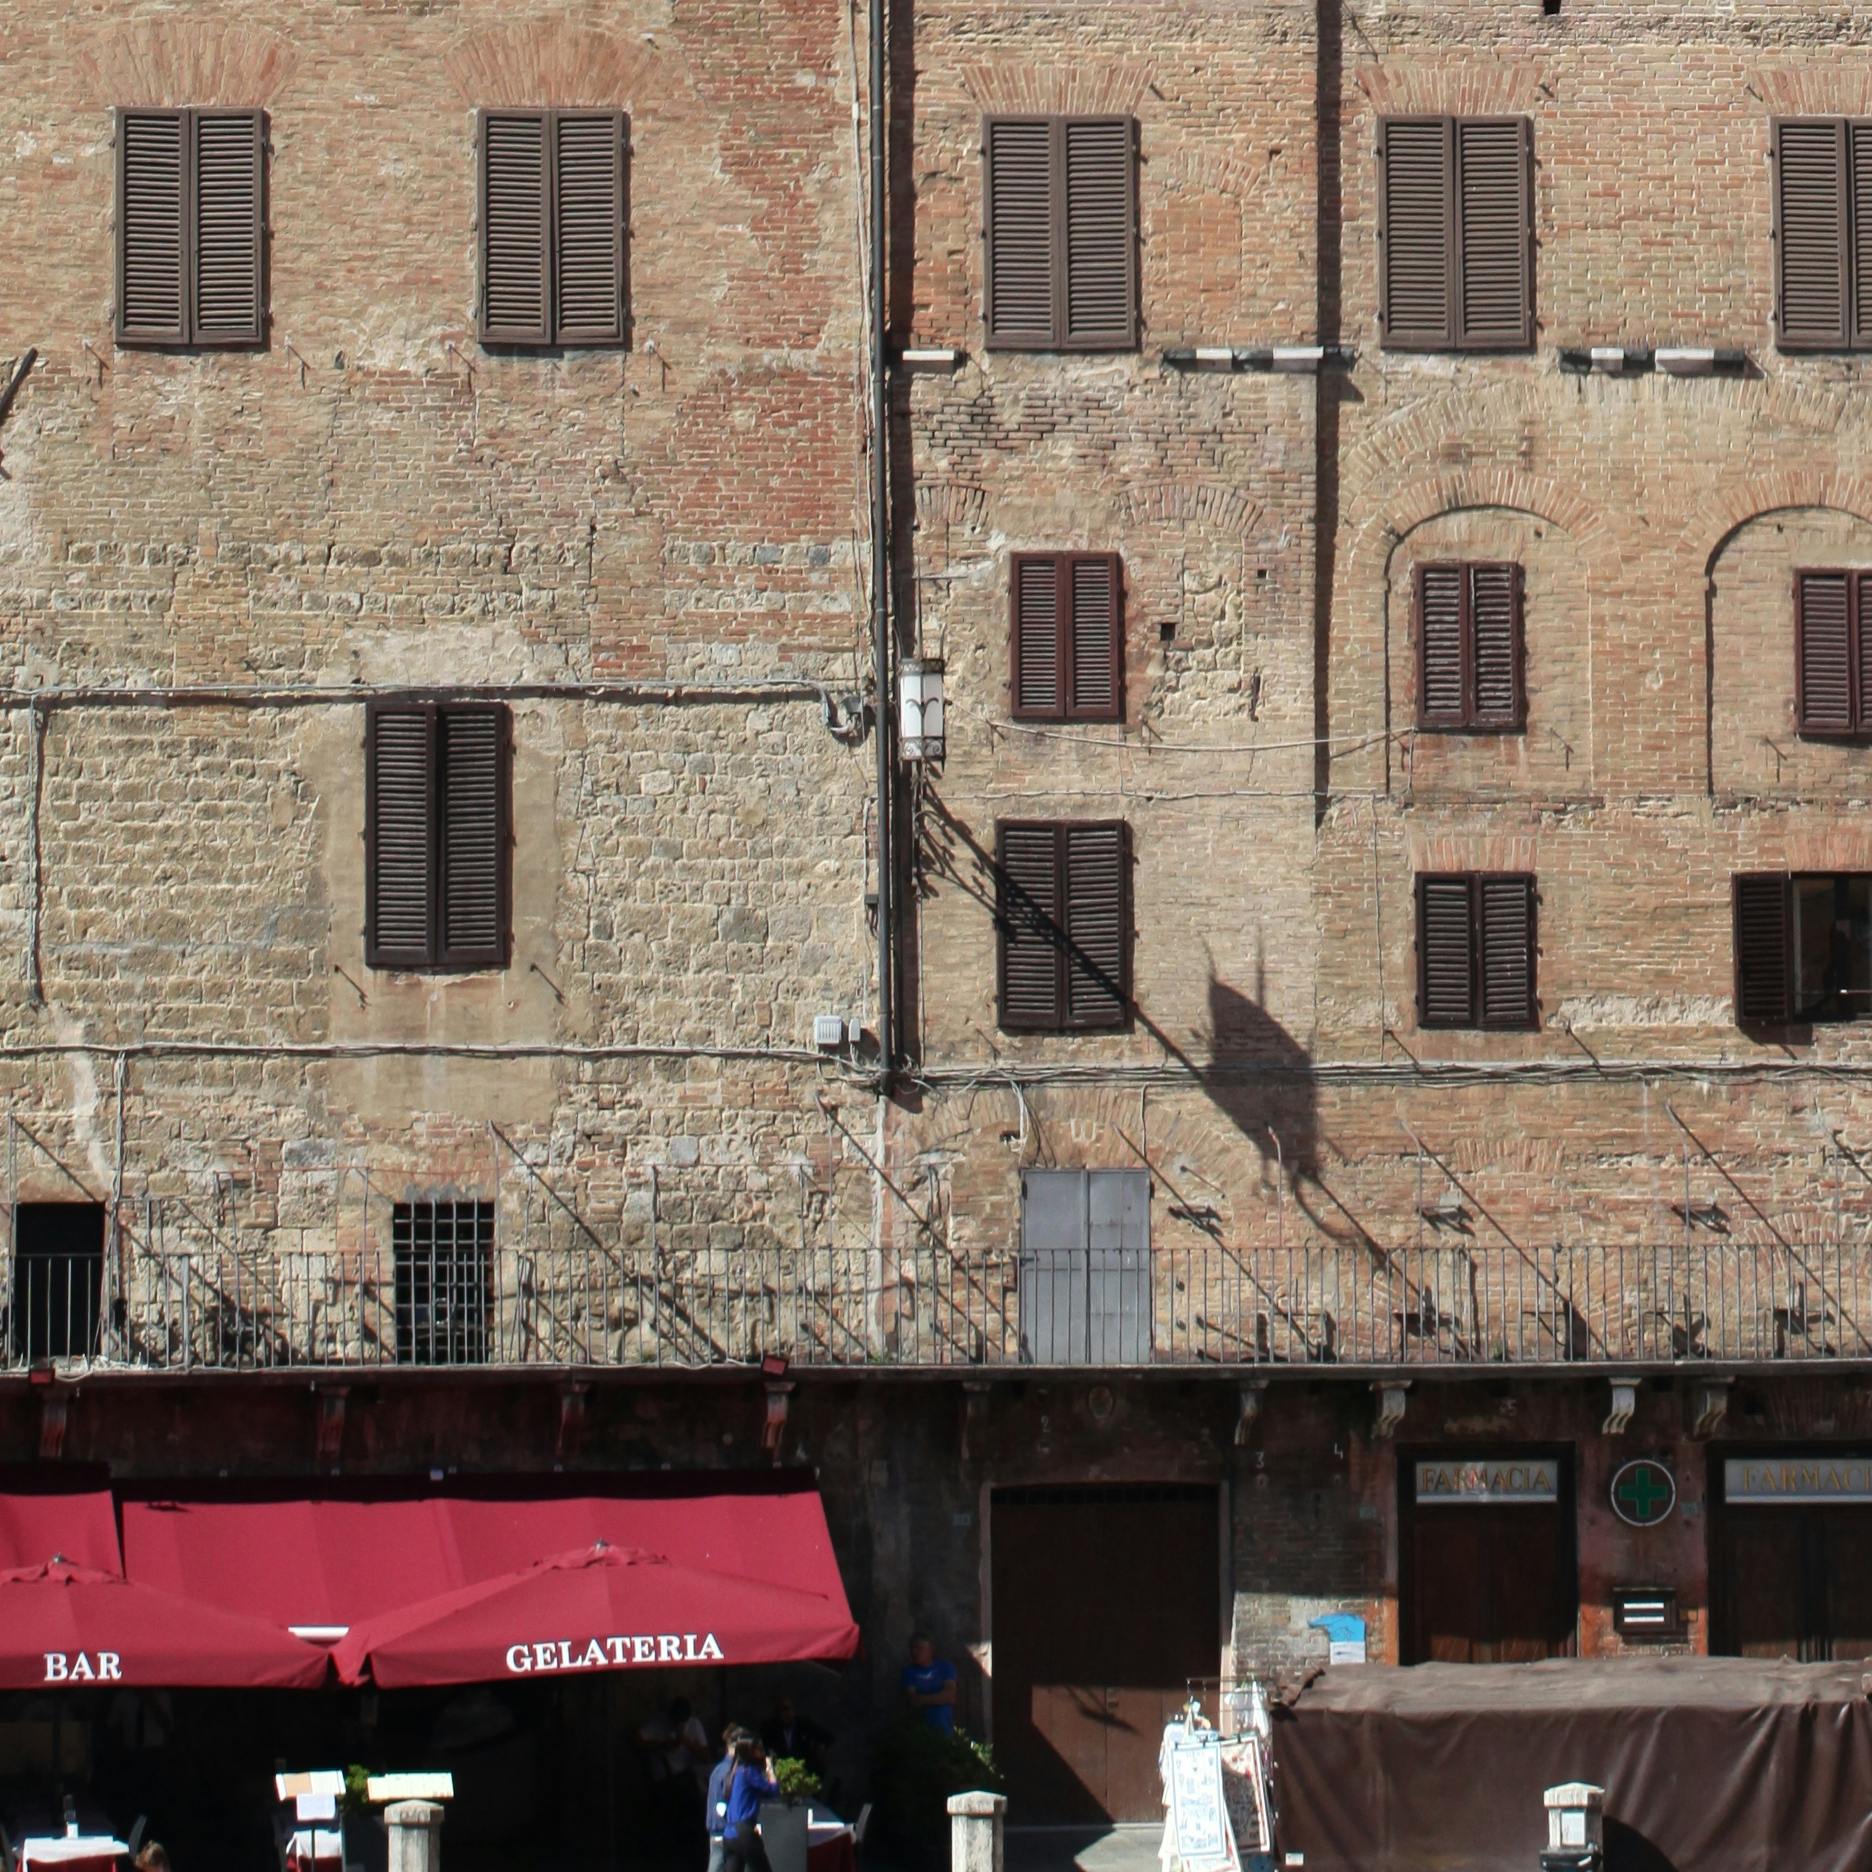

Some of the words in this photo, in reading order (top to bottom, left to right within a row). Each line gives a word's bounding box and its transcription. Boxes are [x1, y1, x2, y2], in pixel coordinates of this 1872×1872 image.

[1422, 1466, 1552, 1491] FARMACIA
[43, 1651, 122, 1681] BAR
[505, 1632, 724, 1673] GELATERIA
